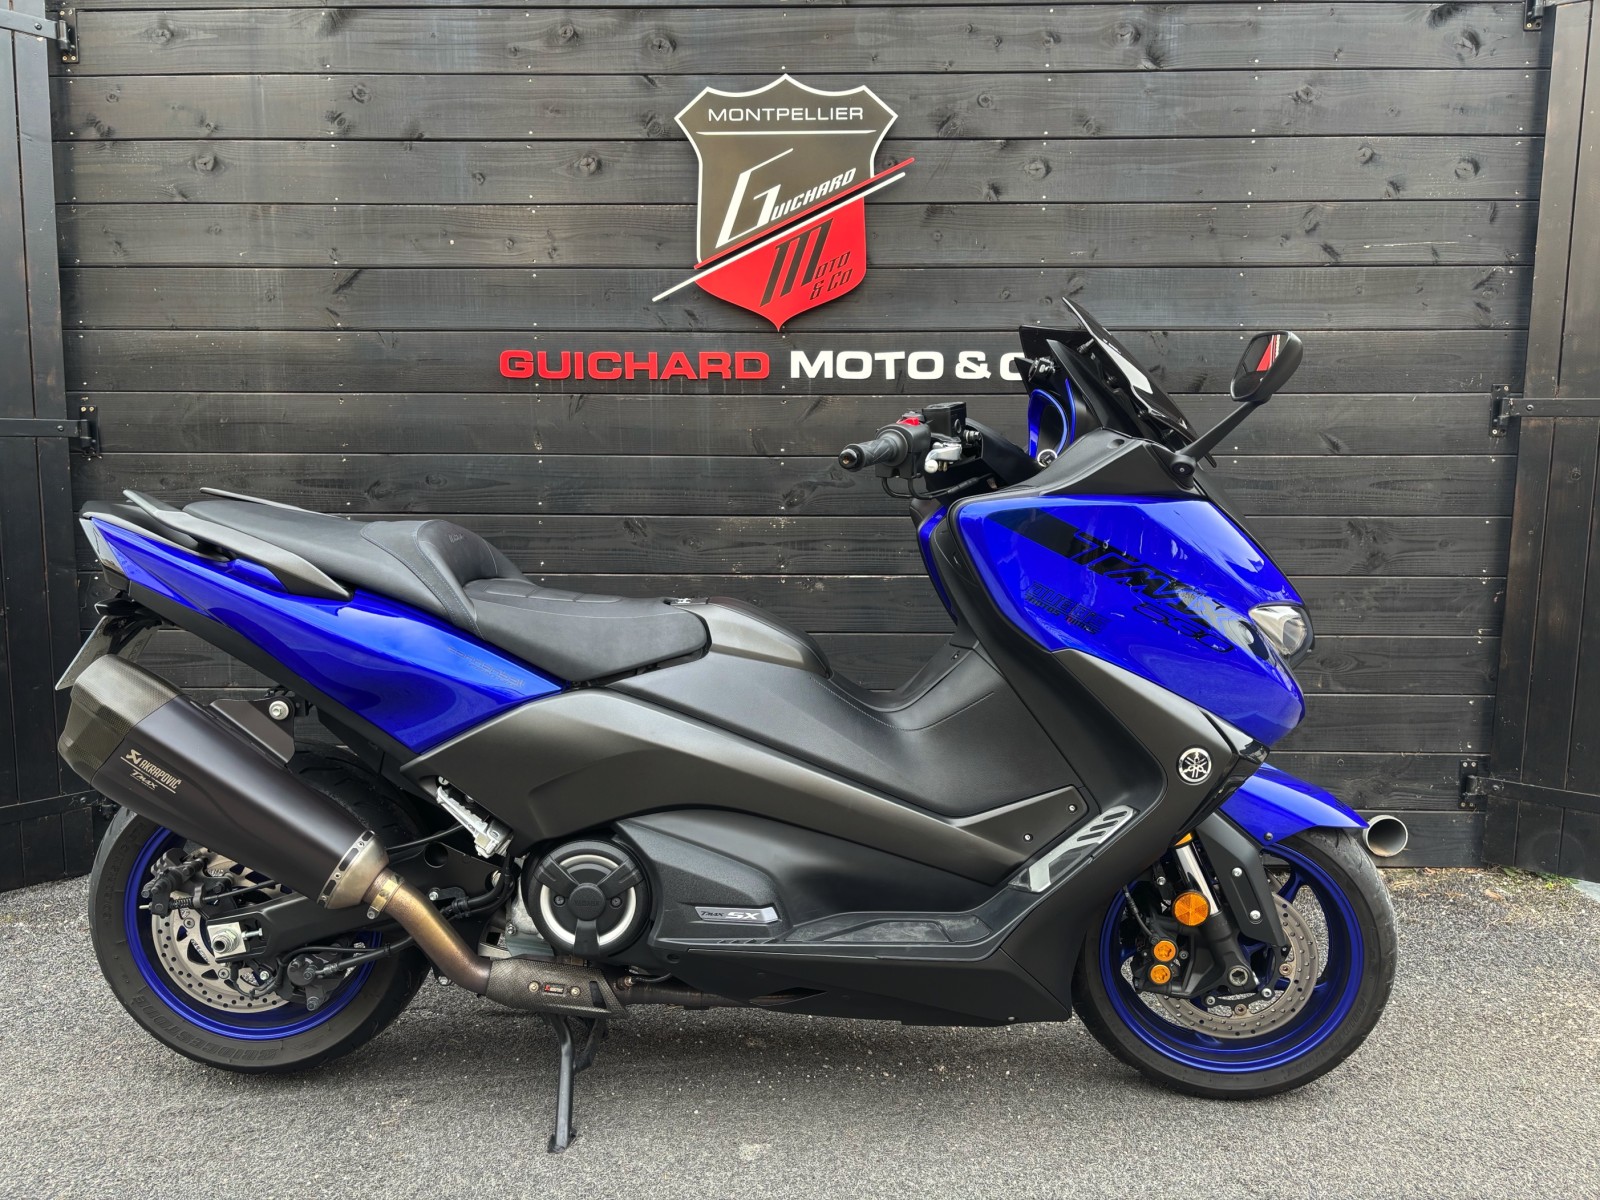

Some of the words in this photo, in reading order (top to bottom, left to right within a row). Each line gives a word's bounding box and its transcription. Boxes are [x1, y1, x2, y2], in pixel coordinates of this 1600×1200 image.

[708, 107, 863, 122] MONTPELLIER
[715, 148, 856, 249] GUICHARD
[500, 350, 770, 380] GUICHARD
[790, 350, 944, 380] MOTO
[955, 354, 992, 380] &
[725, 911, 760, 920] SX
